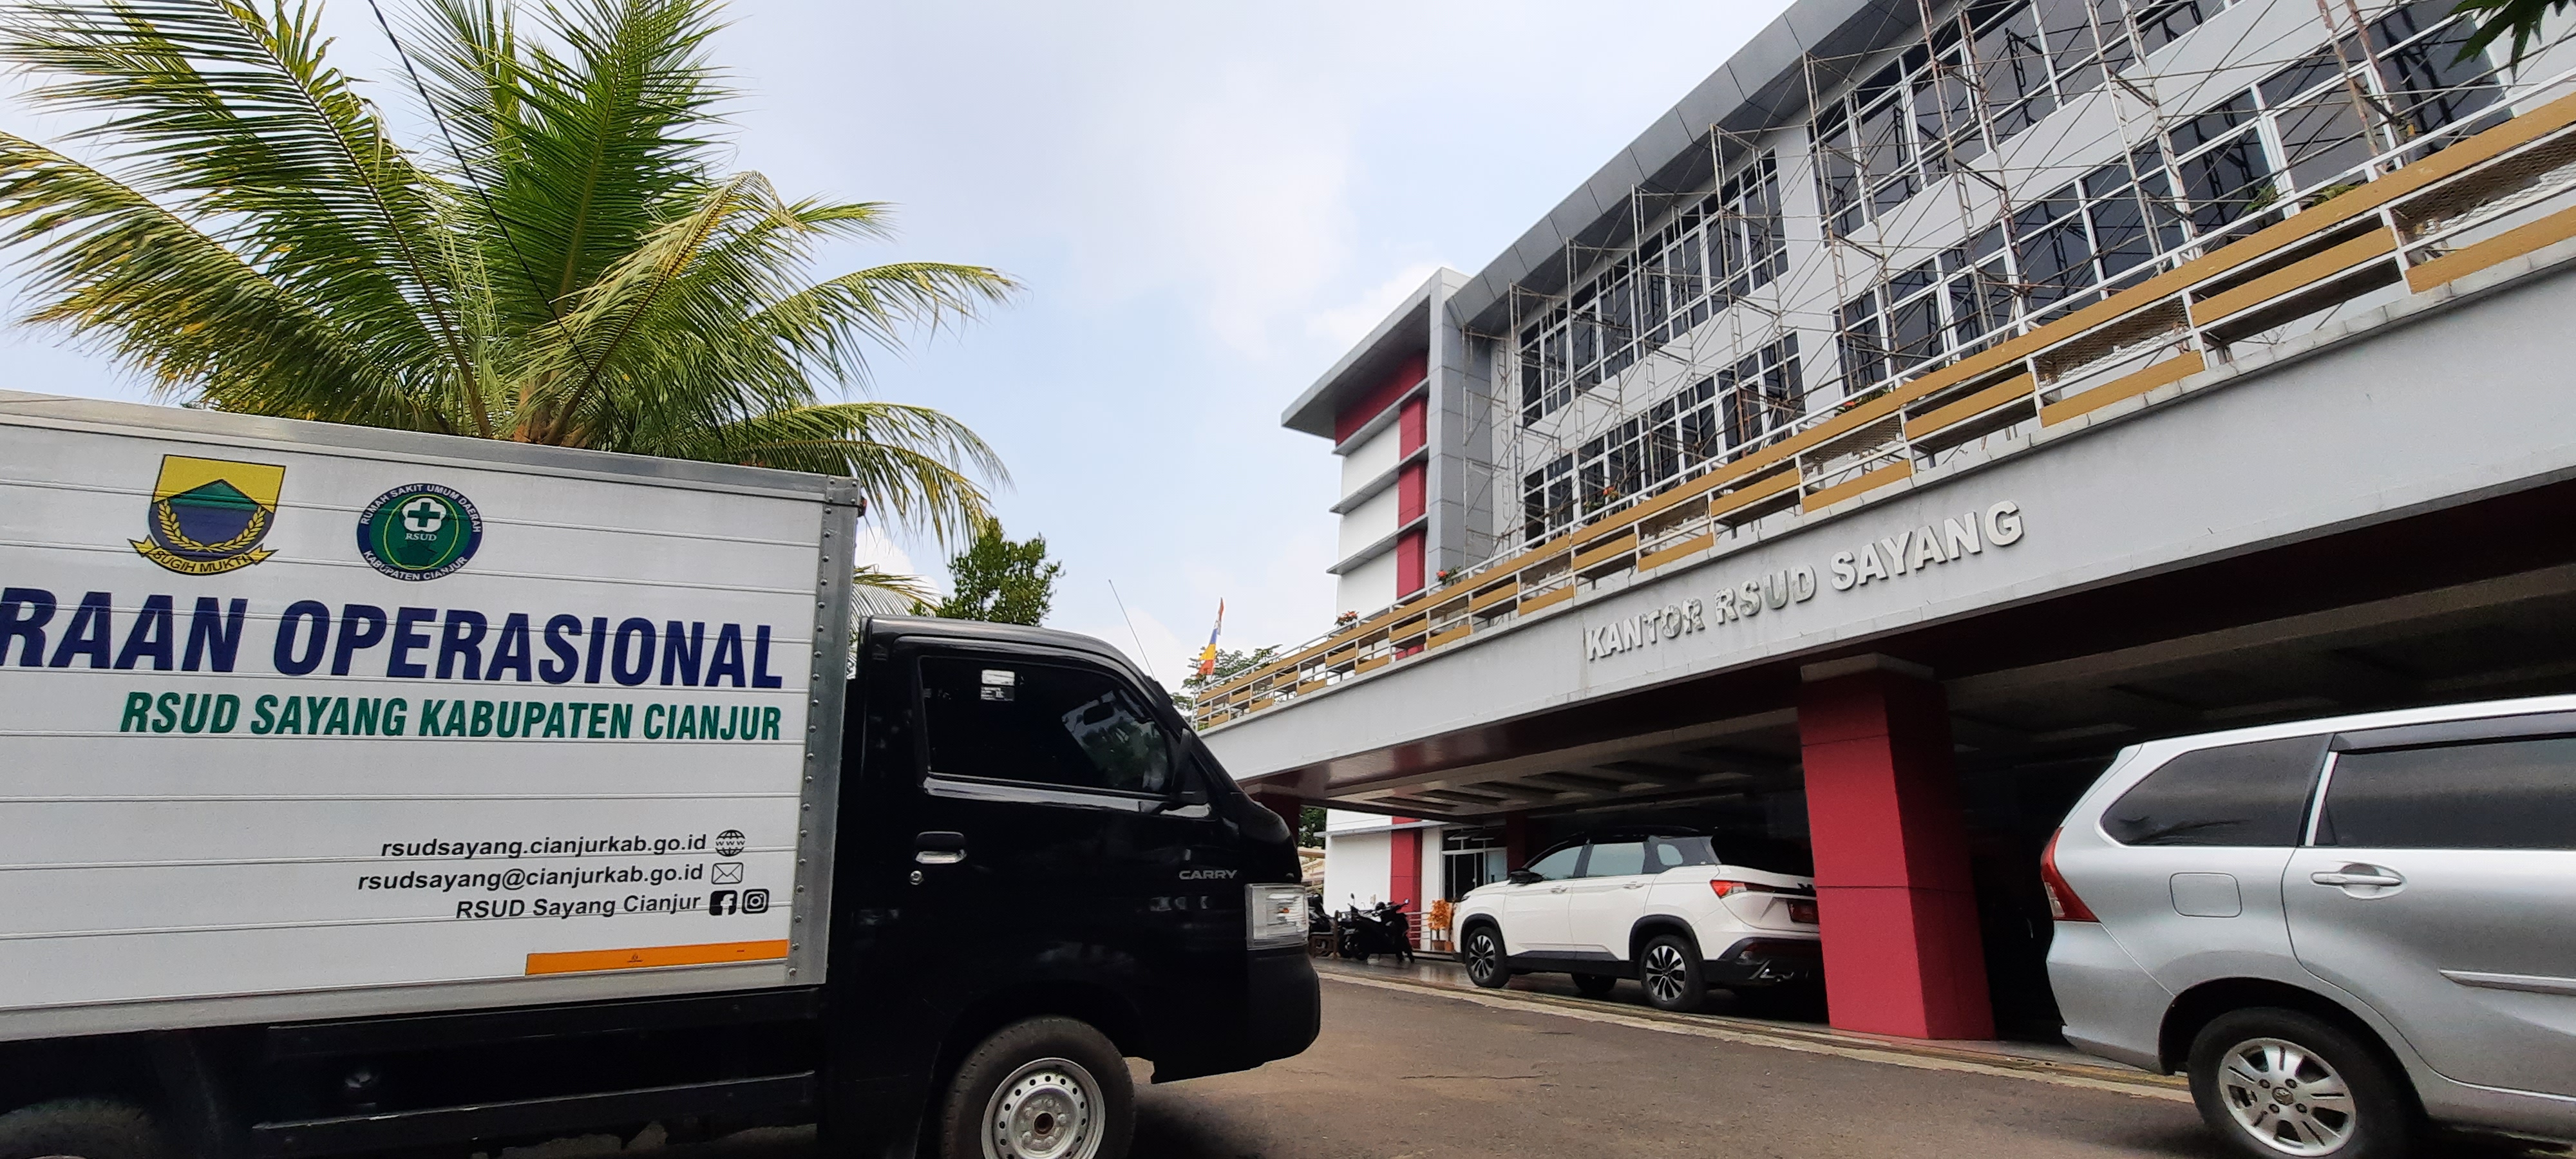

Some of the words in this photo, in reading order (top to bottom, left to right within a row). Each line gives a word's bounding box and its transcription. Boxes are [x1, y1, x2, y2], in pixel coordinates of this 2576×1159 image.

[361, 495, 391, 525] RUMAH
[390, 484, 425, 498] SAKIT
[427, 485, 460, 500] UMUM
[459, 496, 481, 532] DAERAH
[404, 532, 437, 542] RSUD
[152, 550, 194, 572] BUGIH
[363, 551, 421, 580] KABUPATEN
[423, 556, 468, 580] CIANJUR
[1587, 598, 1705, 660] KANTOR
[1714, 563, 1816, 626] RSUD
[1830, 500, 2025, 591] SAYANG
[0, 587, 249, 673] RAAN
[273, 599, 782, 689] OPERASIONAL
[120, 692, 241, 734] RSUD
[251, 695, 406, 737] SAYANG
[419, 699, 633, 739] KABUPATEN
[644, 704, 782, 740] CIANJUR
[381, 834, 706, 859] rsudsayang.cianjurkab.go.id
[358, 863, 703, 892] rsudsayang@cianjurkab.go.id
[1179, 869, 1237, 880] CARRY
[456, 899, 525, 920] RSUD
[533, 896, 616, 918] Sayang
[624, 894, 701, 914] Cianjur
